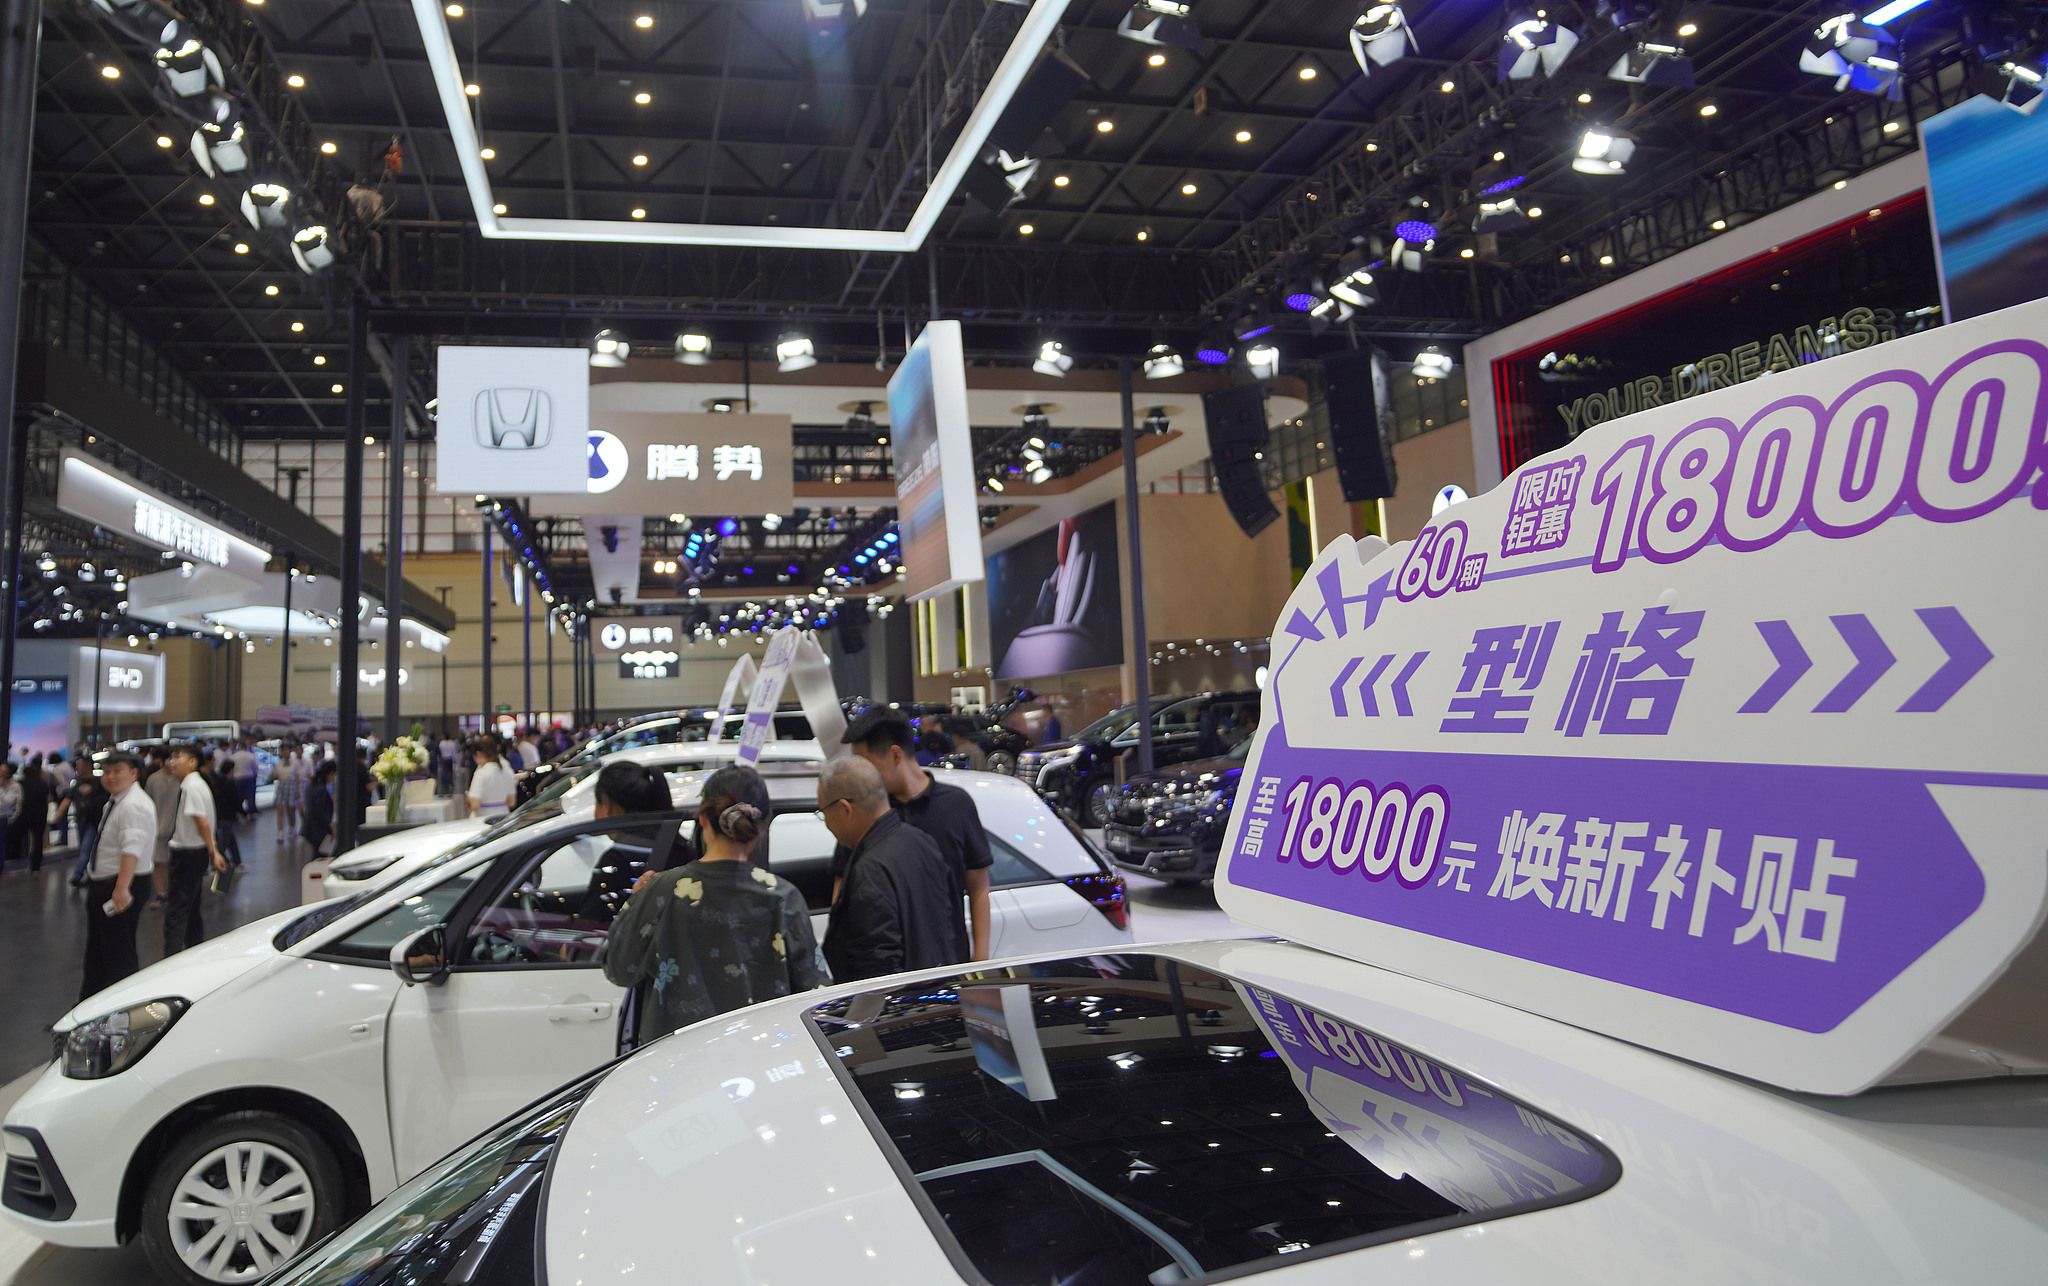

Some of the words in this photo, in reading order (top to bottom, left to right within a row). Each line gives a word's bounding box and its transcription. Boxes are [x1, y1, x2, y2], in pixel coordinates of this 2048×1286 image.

[1557, 375, 1664, 437] YOUR
[646, 444, 763, 481] 腾势
[1591, 338, 2048, 574] 18000
[1513, 461, 1581, 513] 限时
[1505, 503, 1570, 553] 钜惠
[108, 666, 143, 689] BYD
[1439, 605, 1706, 737] 型格
[1239, 776, 1281, 858] 至高
[1487, 809, 1858, 962] 焕新补贴
